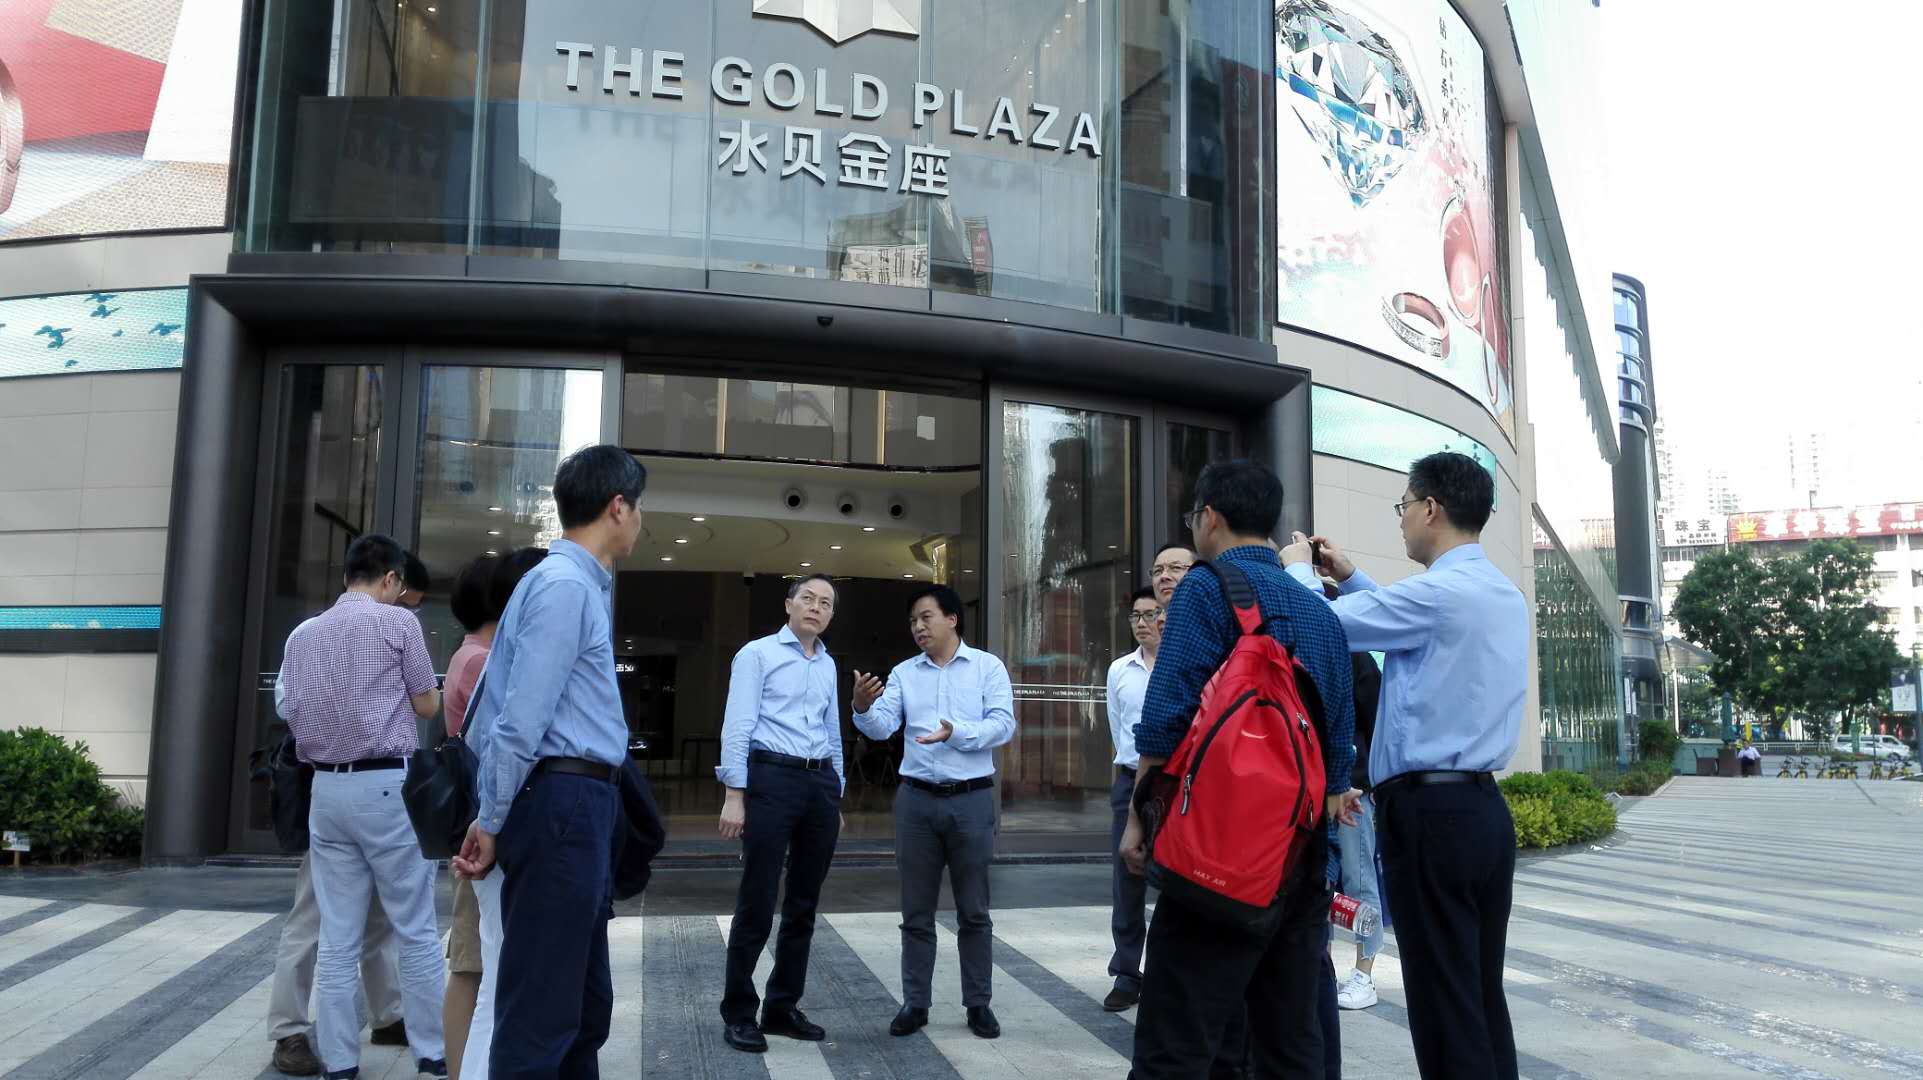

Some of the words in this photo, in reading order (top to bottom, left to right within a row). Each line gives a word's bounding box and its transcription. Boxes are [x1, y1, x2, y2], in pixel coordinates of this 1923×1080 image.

[555, 41, 685, 100] THE
[711, 56, 889, 121] GOLD
[912, 82, 1102, 158] PLAZA
[718, 119, 951, 197] 水贝金座
[1675, 519, 1711, 532] 珠宝
[1193, 869, 1210, 880] MAX
[1212, 878, 1226, 887] AIR
